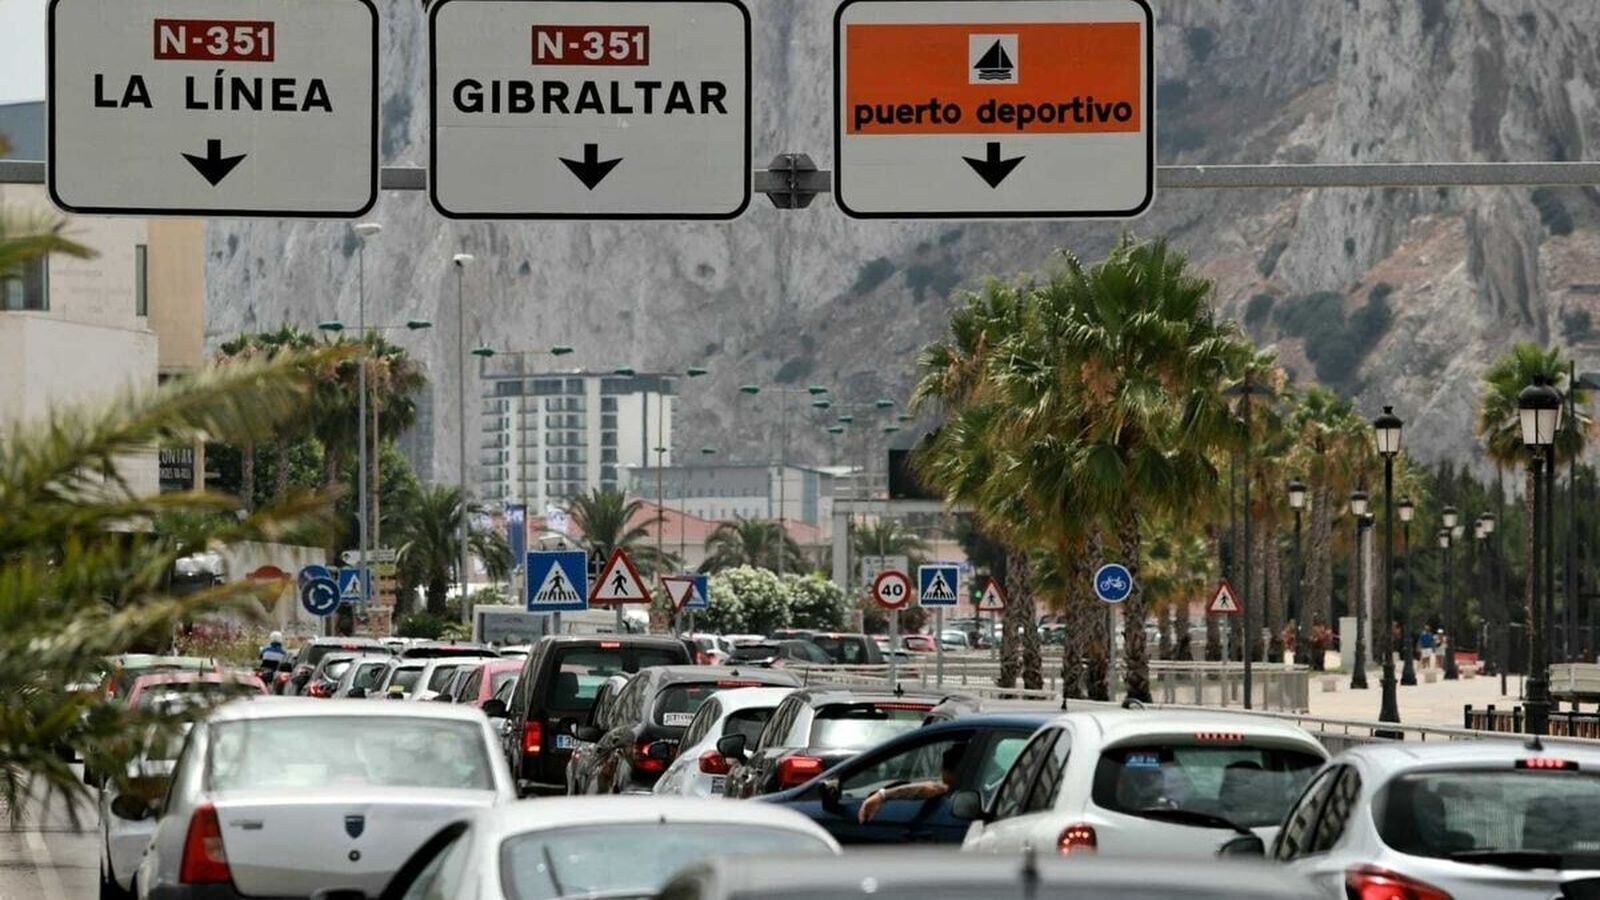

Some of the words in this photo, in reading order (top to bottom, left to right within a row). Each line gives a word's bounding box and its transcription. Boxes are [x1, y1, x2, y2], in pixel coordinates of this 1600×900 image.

[160, 25, 270, 56] N-351
[538, 31, 646, 60] N-351
[94, 74, 153, 108] LA
[185, 69, 333, 112] LÍNEA
[453, 79, 728, 114] GIBRALTAR
[854, 97, 962, 131] puerto
[976, 95, 1133, 130] deportivo
[881, 584, 903, 597] 40
